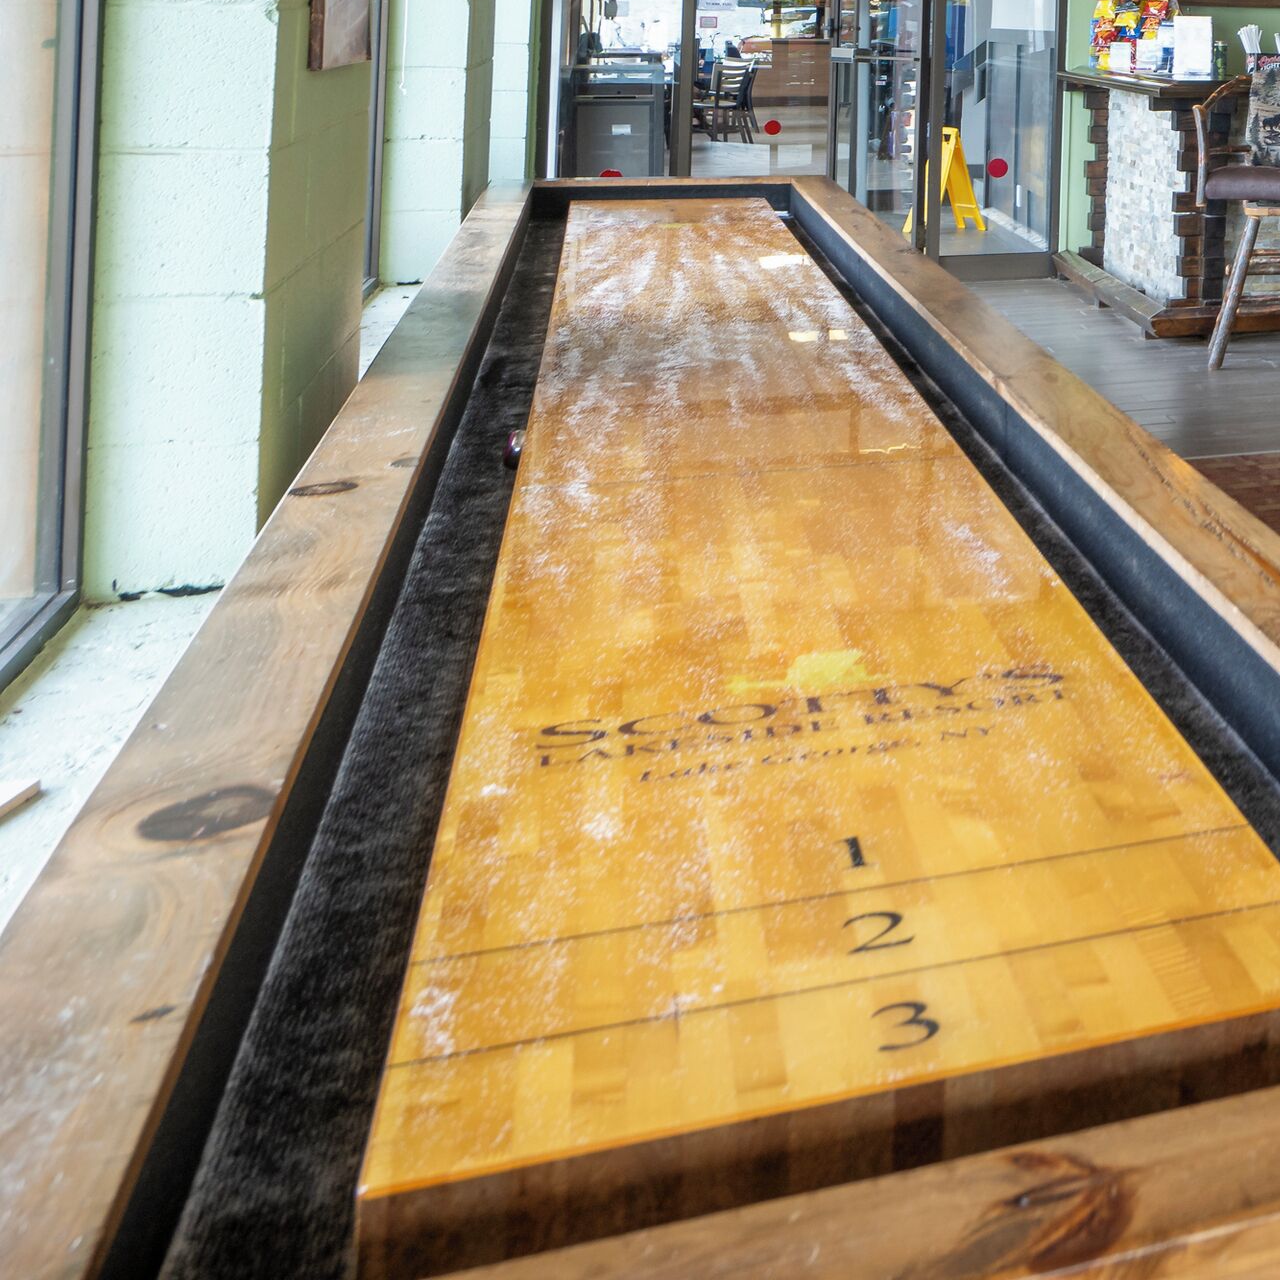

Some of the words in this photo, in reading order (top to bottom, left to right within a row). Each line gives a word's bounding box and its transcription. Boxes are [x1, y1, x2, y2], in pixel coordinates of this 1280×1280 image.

[535, 662, 1065, 750] SCOTTY'S
[838, 835, 878, 869] 1
[842, 911, 915, 956] 2
[870, 1001, 940, 1053] 3
